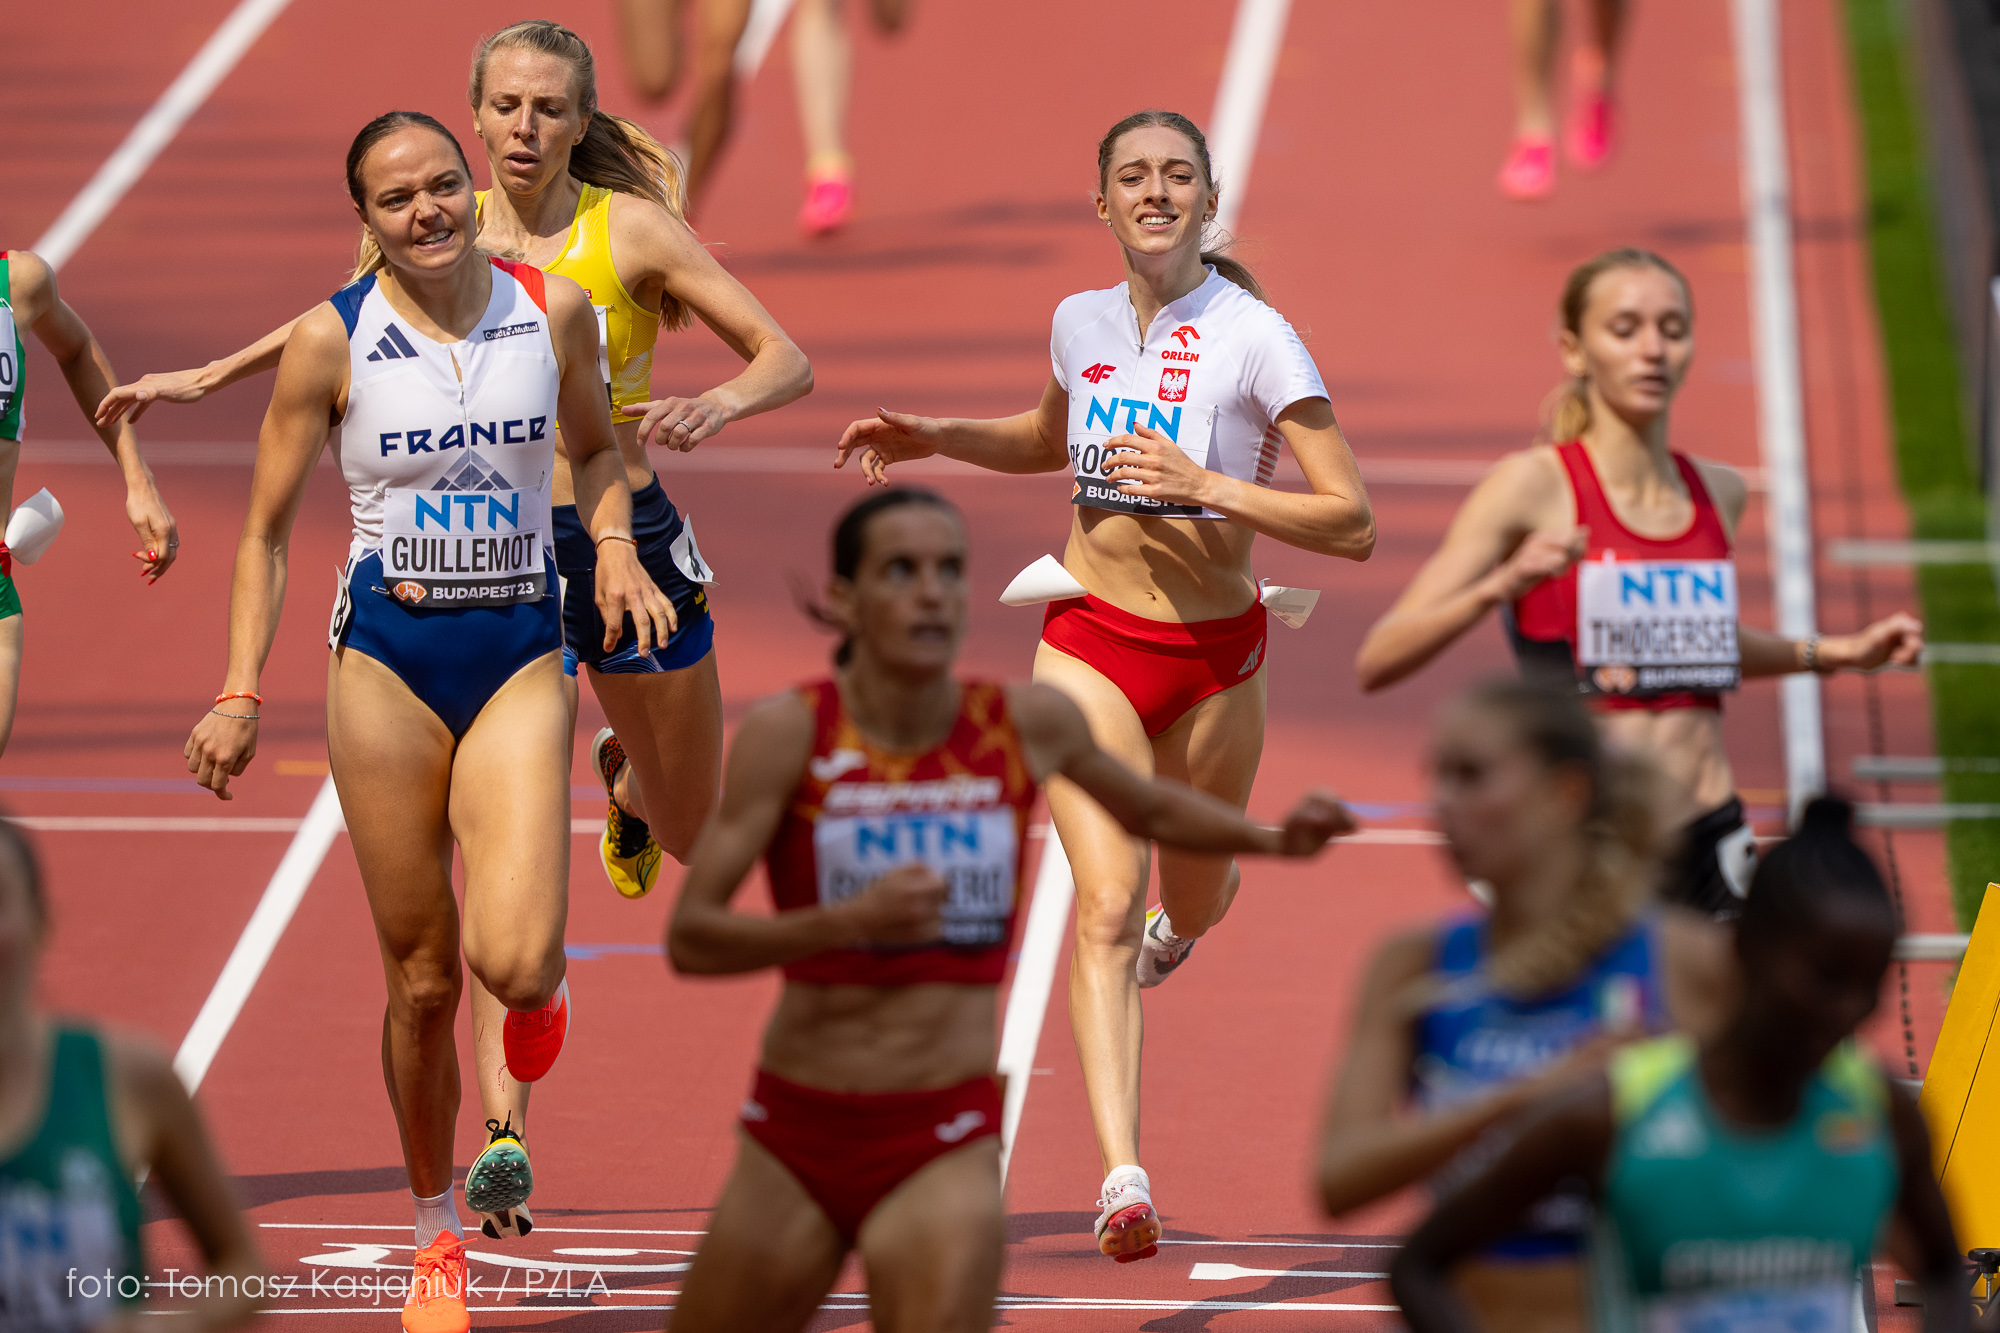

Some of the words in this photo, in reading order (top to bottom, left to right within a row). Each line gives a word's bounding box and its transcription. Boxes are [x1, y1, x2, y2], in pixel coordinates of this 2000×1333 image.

[514, 324, 538, 334] Mutuel
[1081, 363, 1117, 384] 4F
[1161, 350, 1199, 362] ORLEN
[379, 415, 547, 457] FRANCE
[1086, 395, 1182, 444] NTN
[415, 492, 520, 532] NTN
[391, 532, 536, 573] GUILLEMOT
[432, 584, 516, 600] BUDAPEST
[517, 581, 535, 595] 23
[1619, 567, 1726, 607] NTN
[857, 814, 981, 861] NTN
